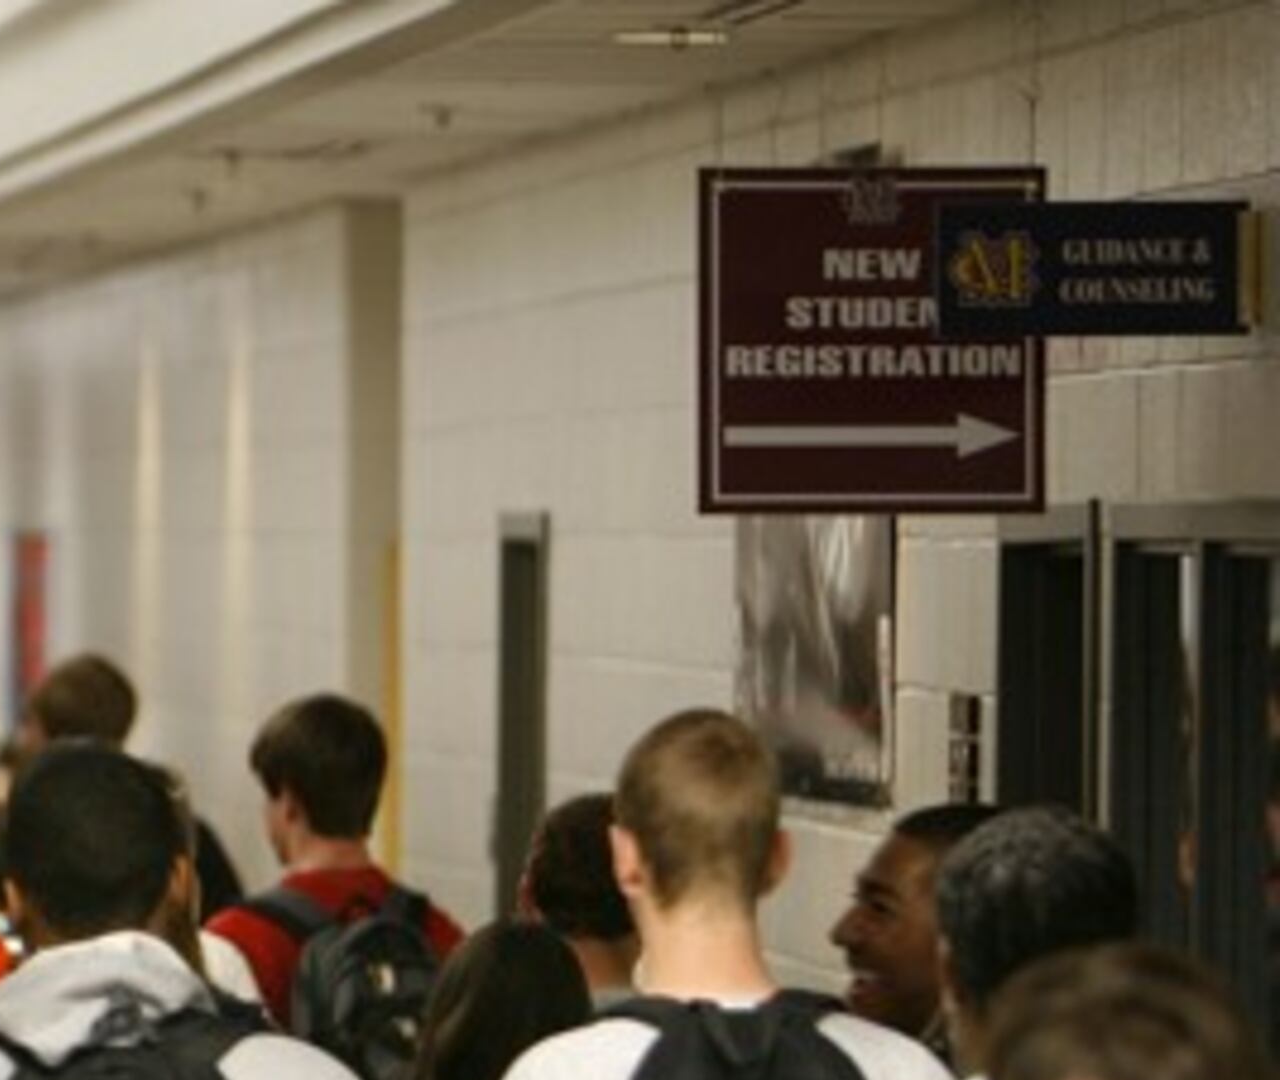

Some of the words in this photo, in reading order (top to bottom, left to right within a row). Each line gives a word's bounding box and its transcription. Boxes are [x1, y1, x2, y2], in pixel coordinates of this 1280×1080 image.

[822, 248, 922, 280] NEW
[1061, 237, 1182, 266] GUIDANCE
[1192, 238, 1211, 265] &
[1057, 277, 1215, 304] COUNSELING
[785, 295, 938, 329] STUDEN
[725, 344, 1022, 377] REGISTRATION
